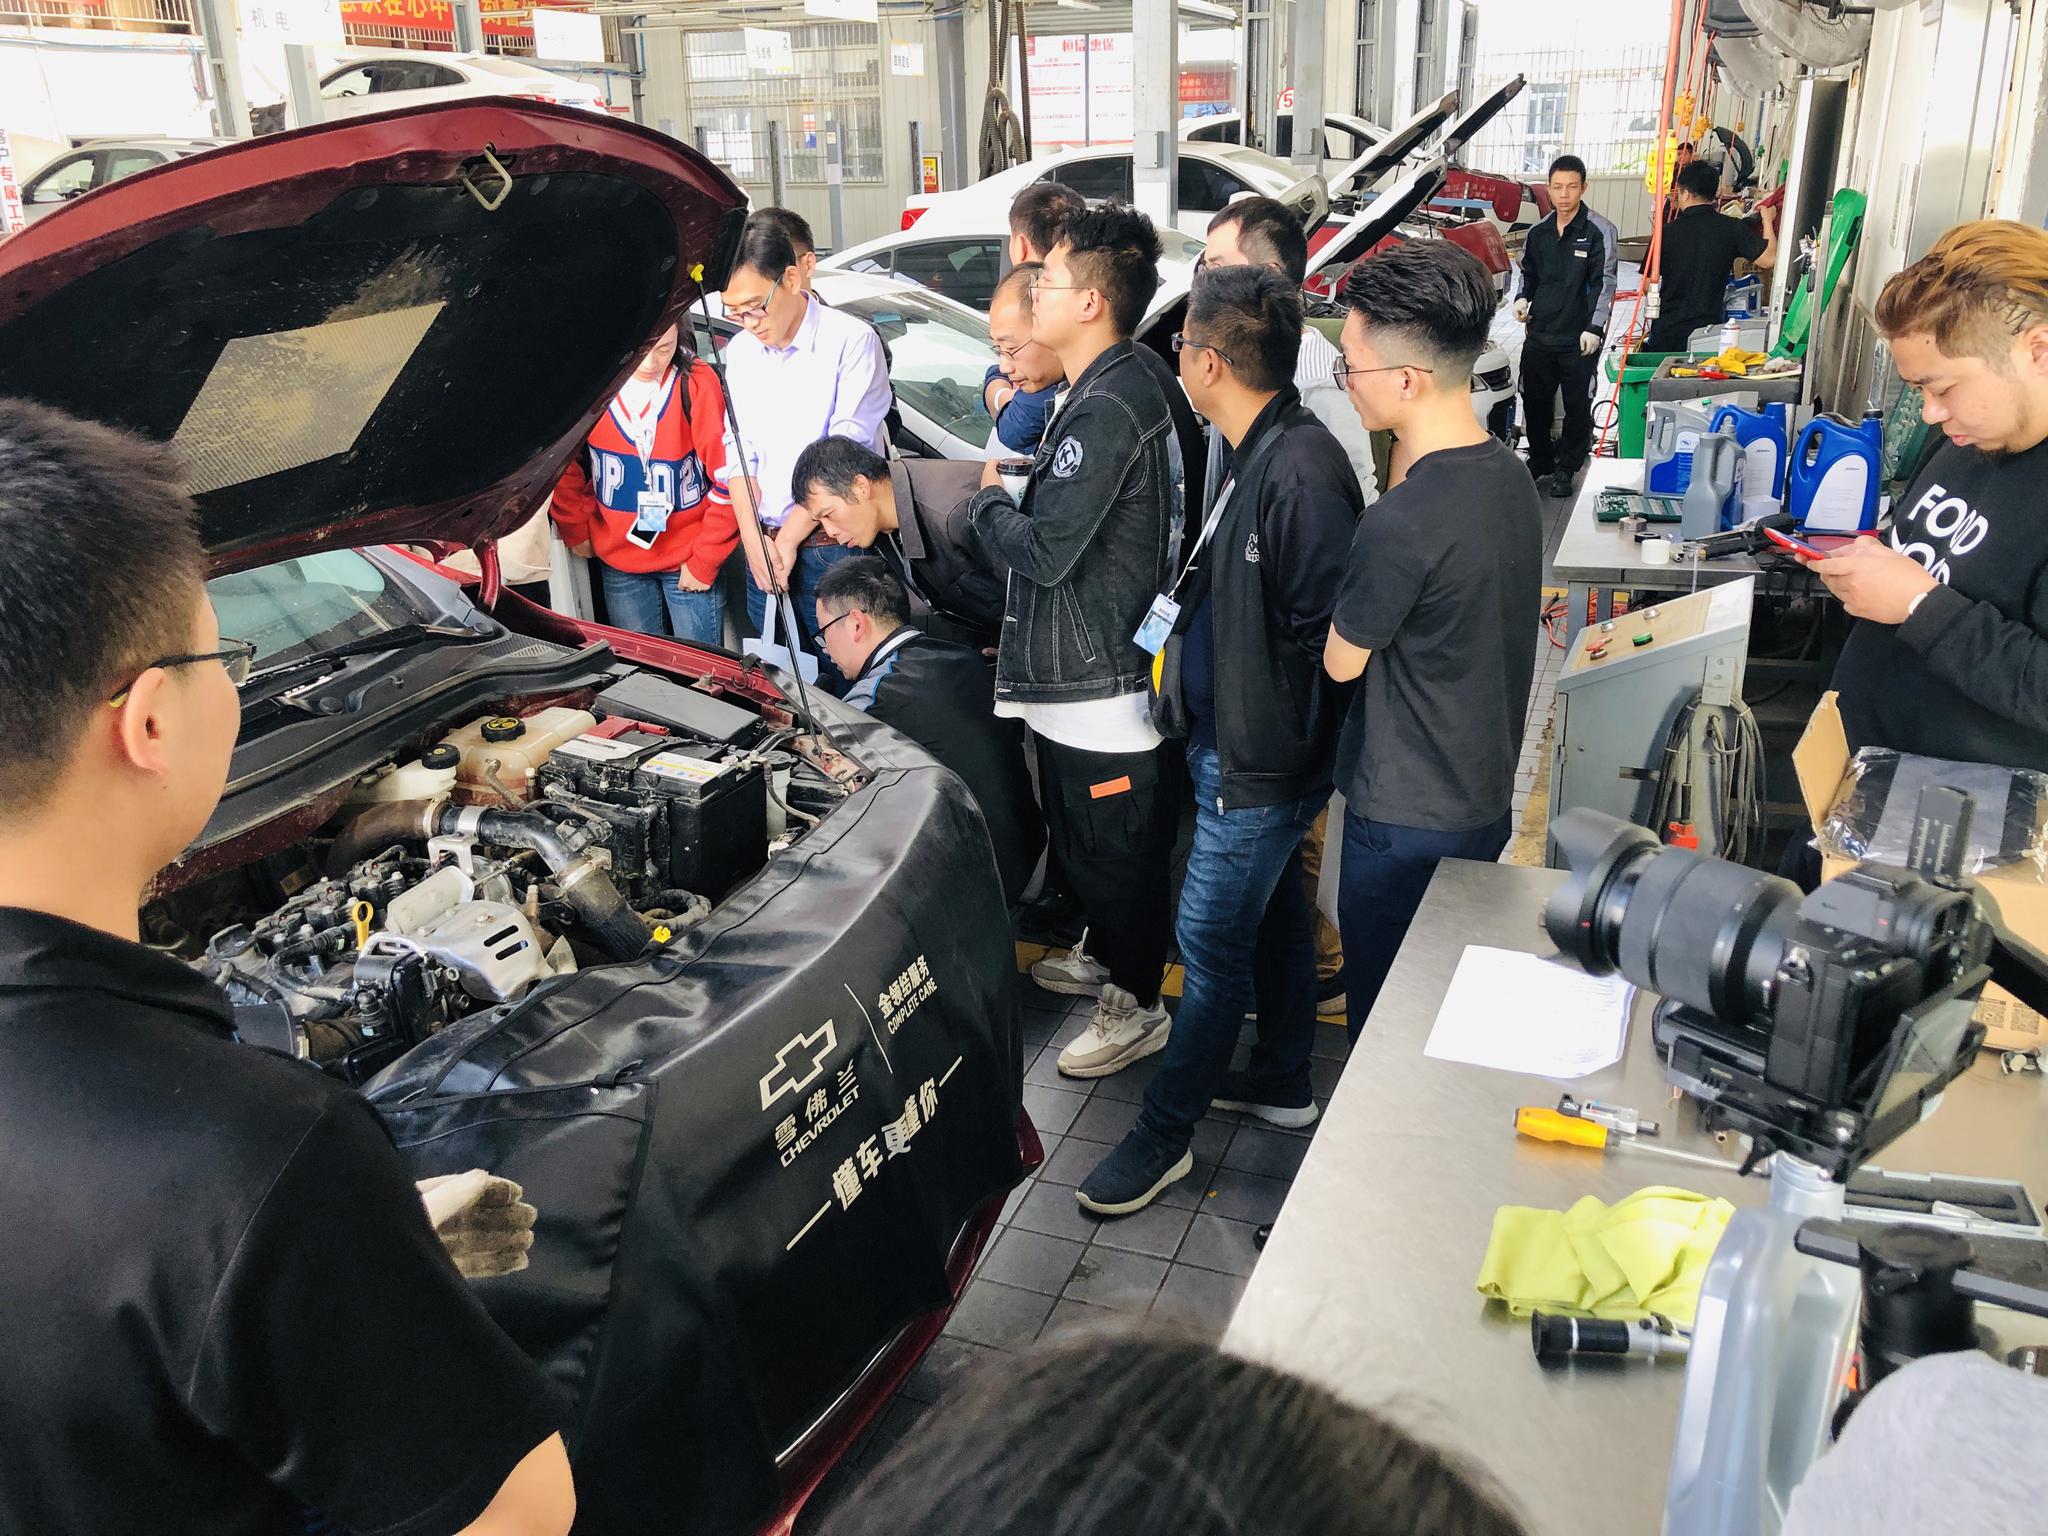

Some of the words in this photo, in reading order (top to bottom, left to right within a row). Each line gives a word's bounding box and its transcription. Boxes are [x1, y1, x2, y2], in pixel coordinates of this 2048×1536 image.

[249, 7, 290, 31] 机电
[1283, 93, 1294, 108] 5
[878, 954, 930, 1020] 金领结服务
[887, 992, 920, 1035] COMPLETE
[918, 976, 938, 1002] CARE
[775, 1058, 857, 1151] 雪佛兰
[780, 1084, 859, 1168] CHEVROLET
